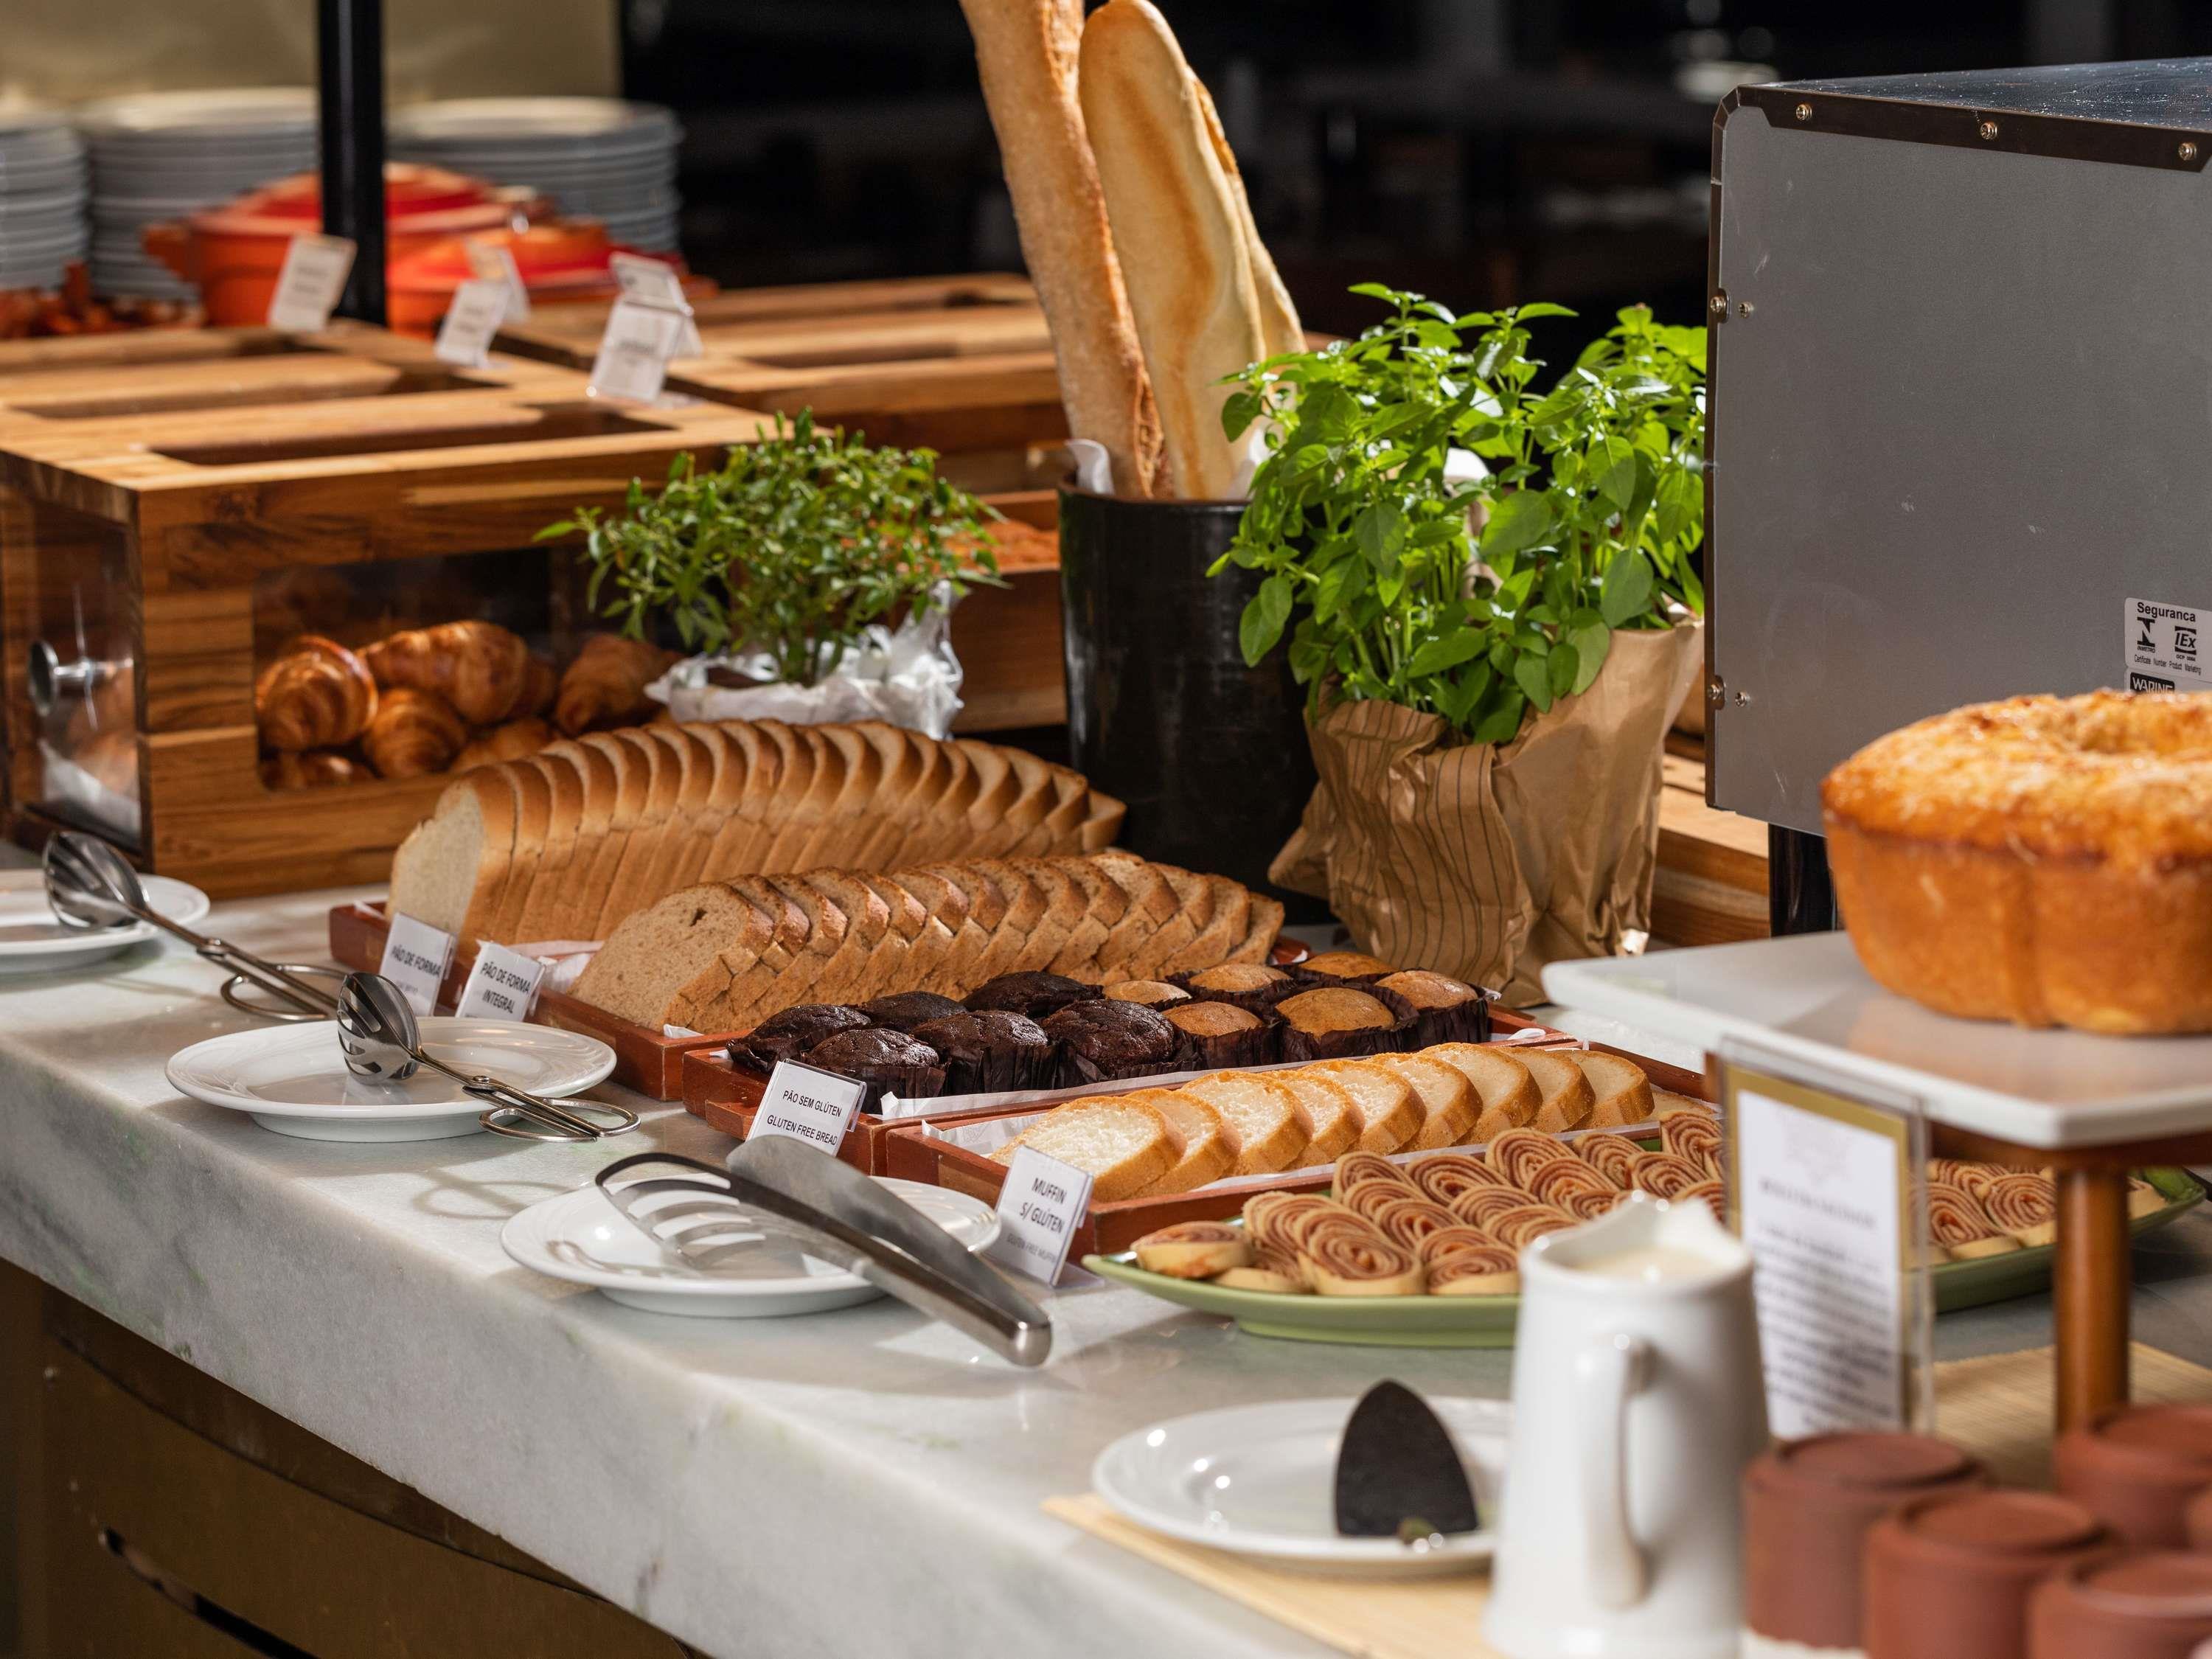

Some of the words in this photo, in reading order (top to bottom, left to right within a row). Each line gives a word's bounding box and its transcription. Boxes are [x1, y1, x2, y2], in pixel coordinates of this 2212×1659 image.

[392, 945, 406, 962] PÃO
[404, 951, 414, 967] DE
[414, 956, 442, 978] FORMA
[481, 961, 498, 979] PÃO
[498, 969, 507, 984] DE
[505, 972, 532, 994] FORMA
[482, 989, 515, 1014] INTEGRAL
[782, 1090, 799, 1104] PÃO
[799, 1095, 814, 1109] SEM
[815, 1100, 842, 1118] GLÚTEN
[767, 1114, 798, 1133] GLUTEN
[797, 1124, 816, 1138] FREE
[815, 1130, 838, 1146] BREAD
[1032, 1178, 1067, 1204] MUFFIN
[1020, 1202, 1034, 1220] S/
[1032, 1207, 1065, 1234] GLÚTEN
